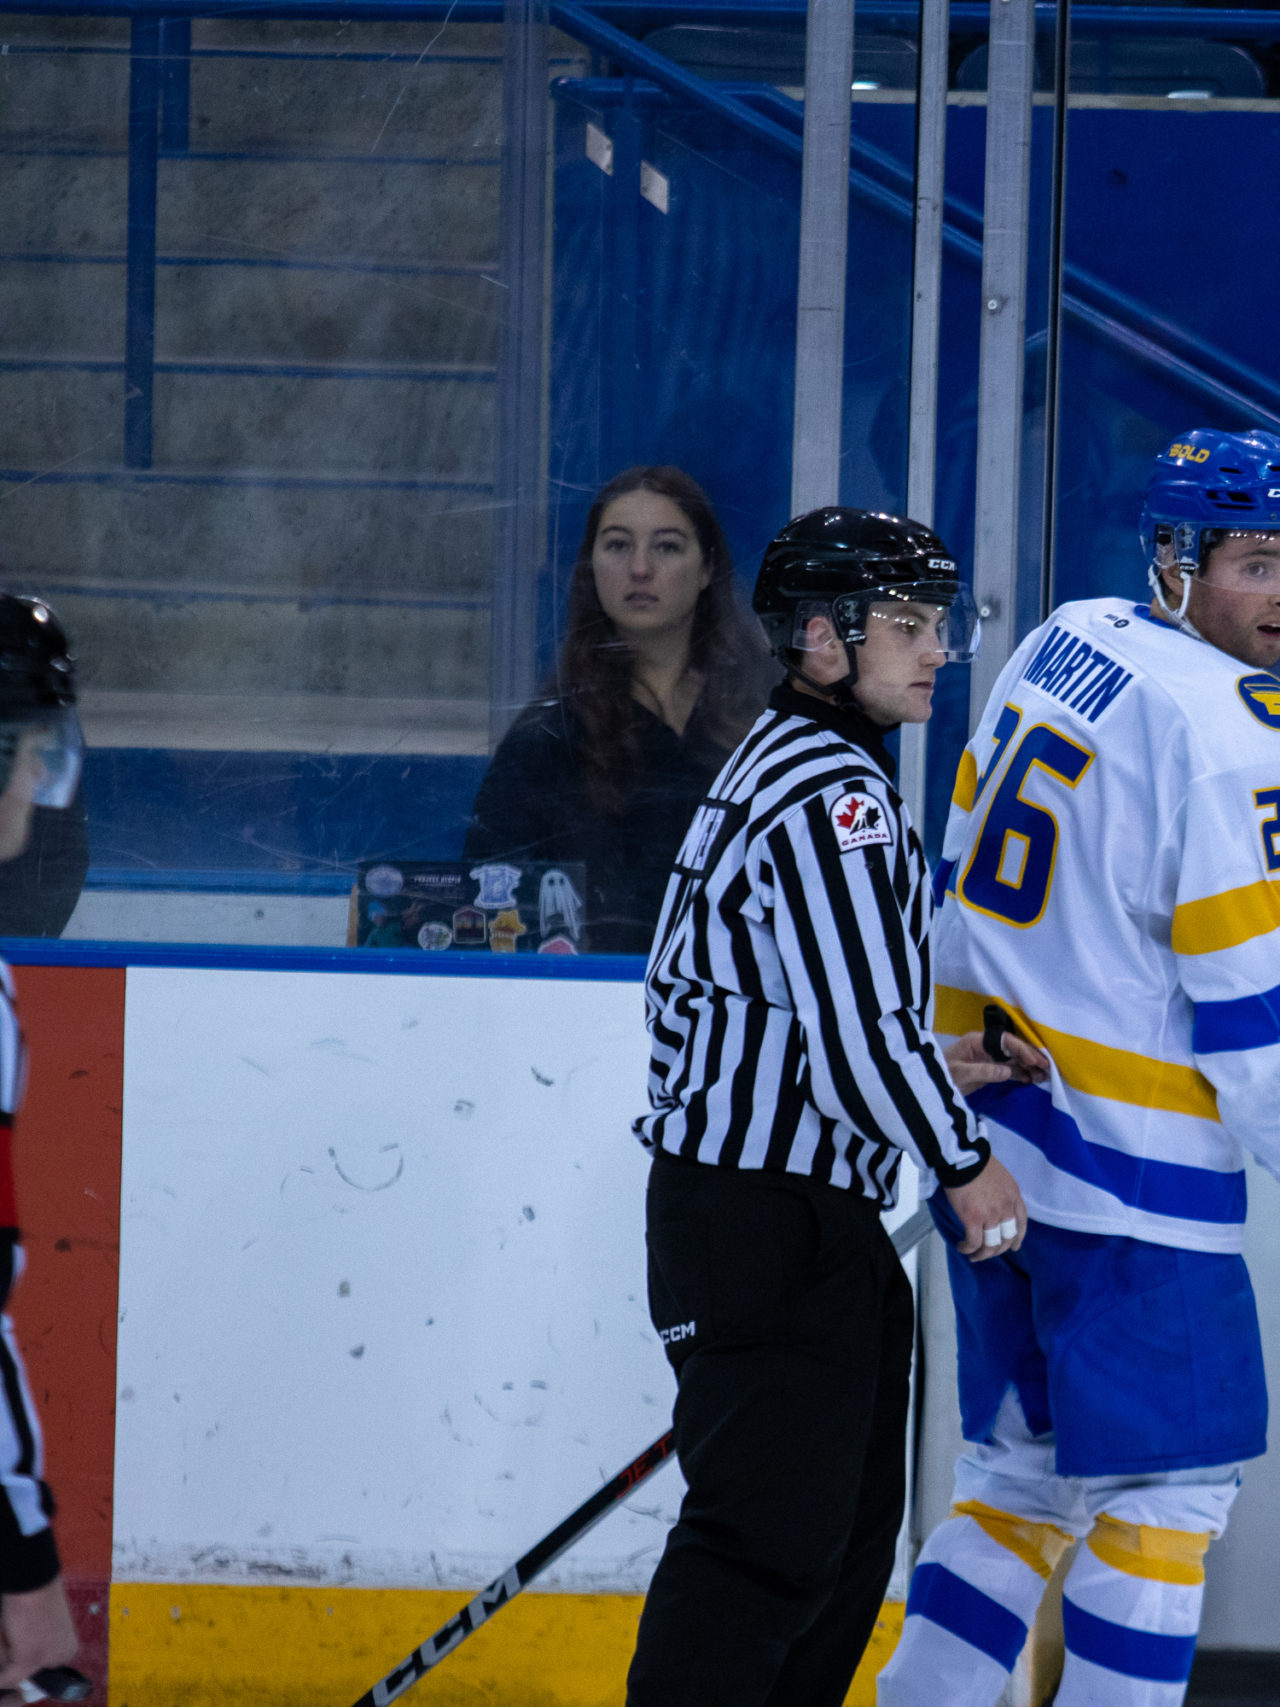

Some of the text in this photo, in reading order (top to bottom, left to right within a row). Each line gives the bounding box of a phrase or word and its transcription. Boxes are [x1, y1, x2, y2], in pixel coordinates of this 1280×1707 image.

[1023, 626, 1134, 723] MARTIN
[841, 833, 888, 846] CANADA
[659, 1320, 696, 1345] CCM
[372, 1564, 524, 1707] CCM
